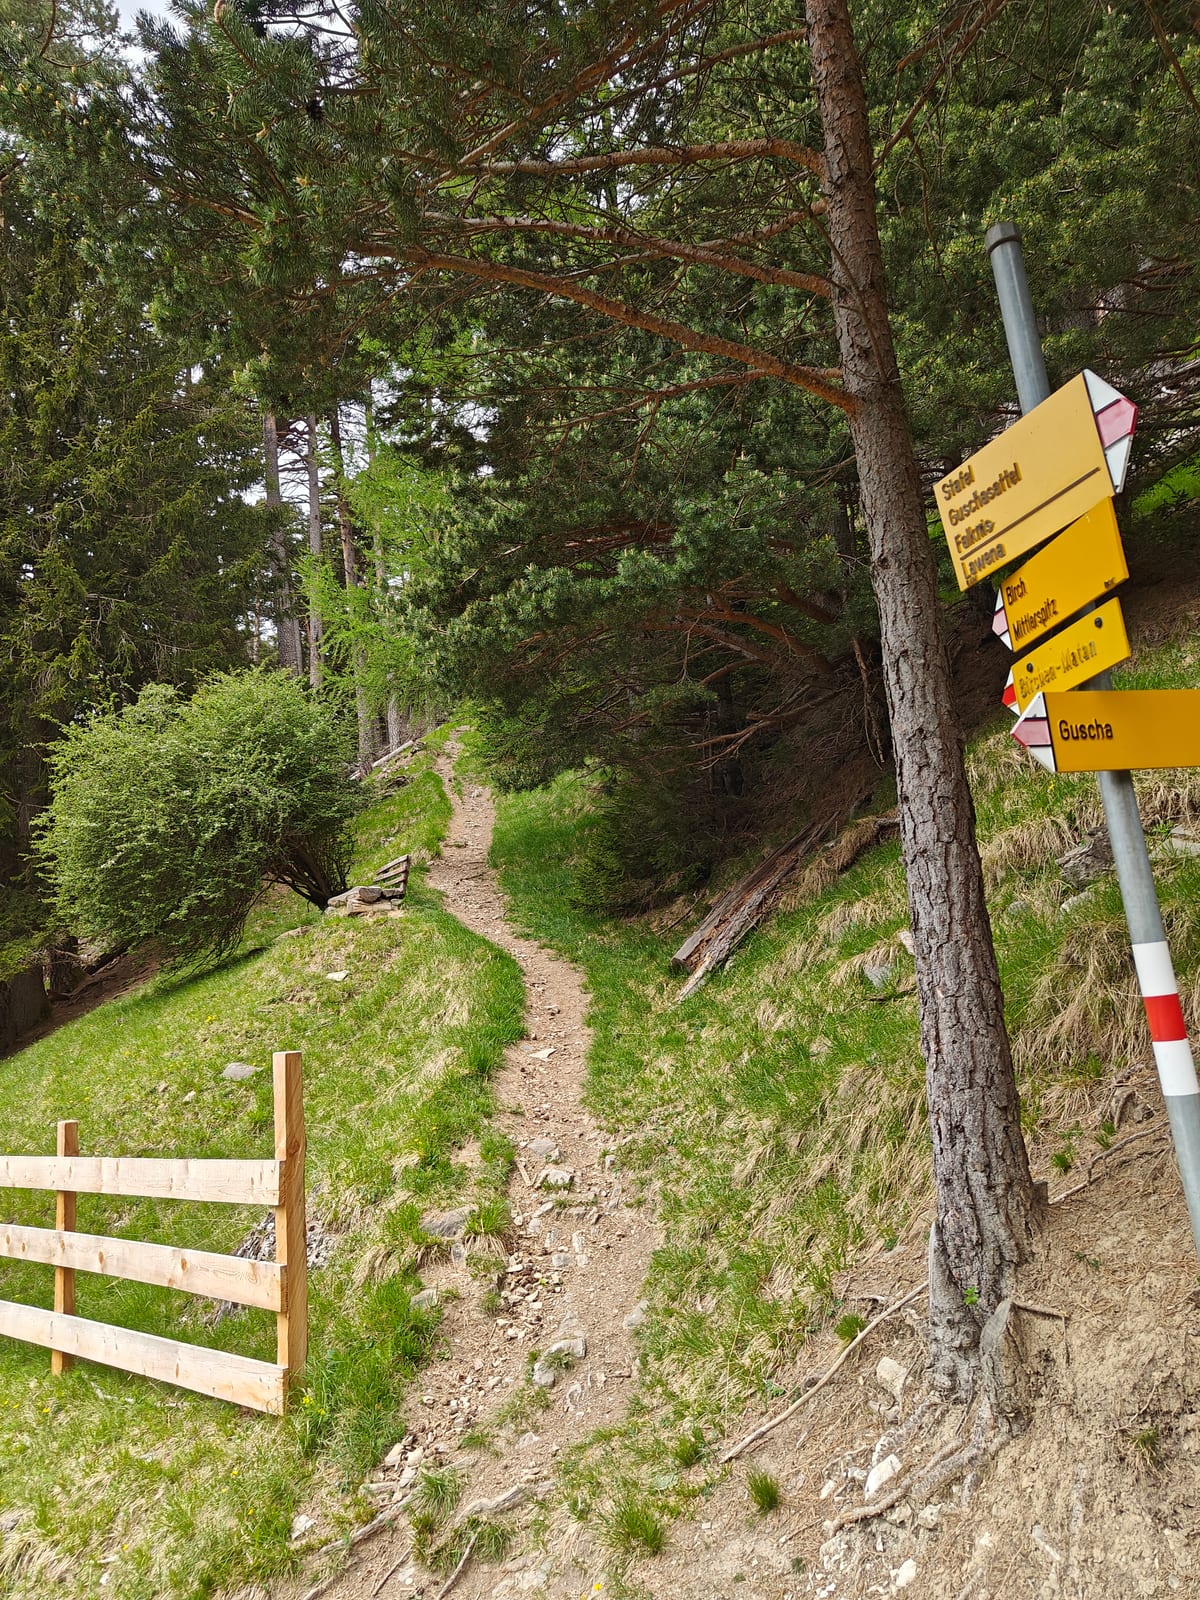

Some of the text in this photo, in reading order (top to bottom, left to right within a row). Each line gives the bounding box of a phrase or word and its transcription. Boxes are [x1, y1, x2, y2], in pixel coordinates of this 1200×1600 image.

[941, 465, 975, 501] Stafel
[948, 462, 1022, 526] Guschasattel
[954, 519, 996, 554] Falknis
[961, 543, 1006, 579] Lawena
[1005, 578, 1028, 606] Birch
[1012, 598, 1058, 642] Mittlerspitz
[1058, 718, 1114, 742] Guscha
